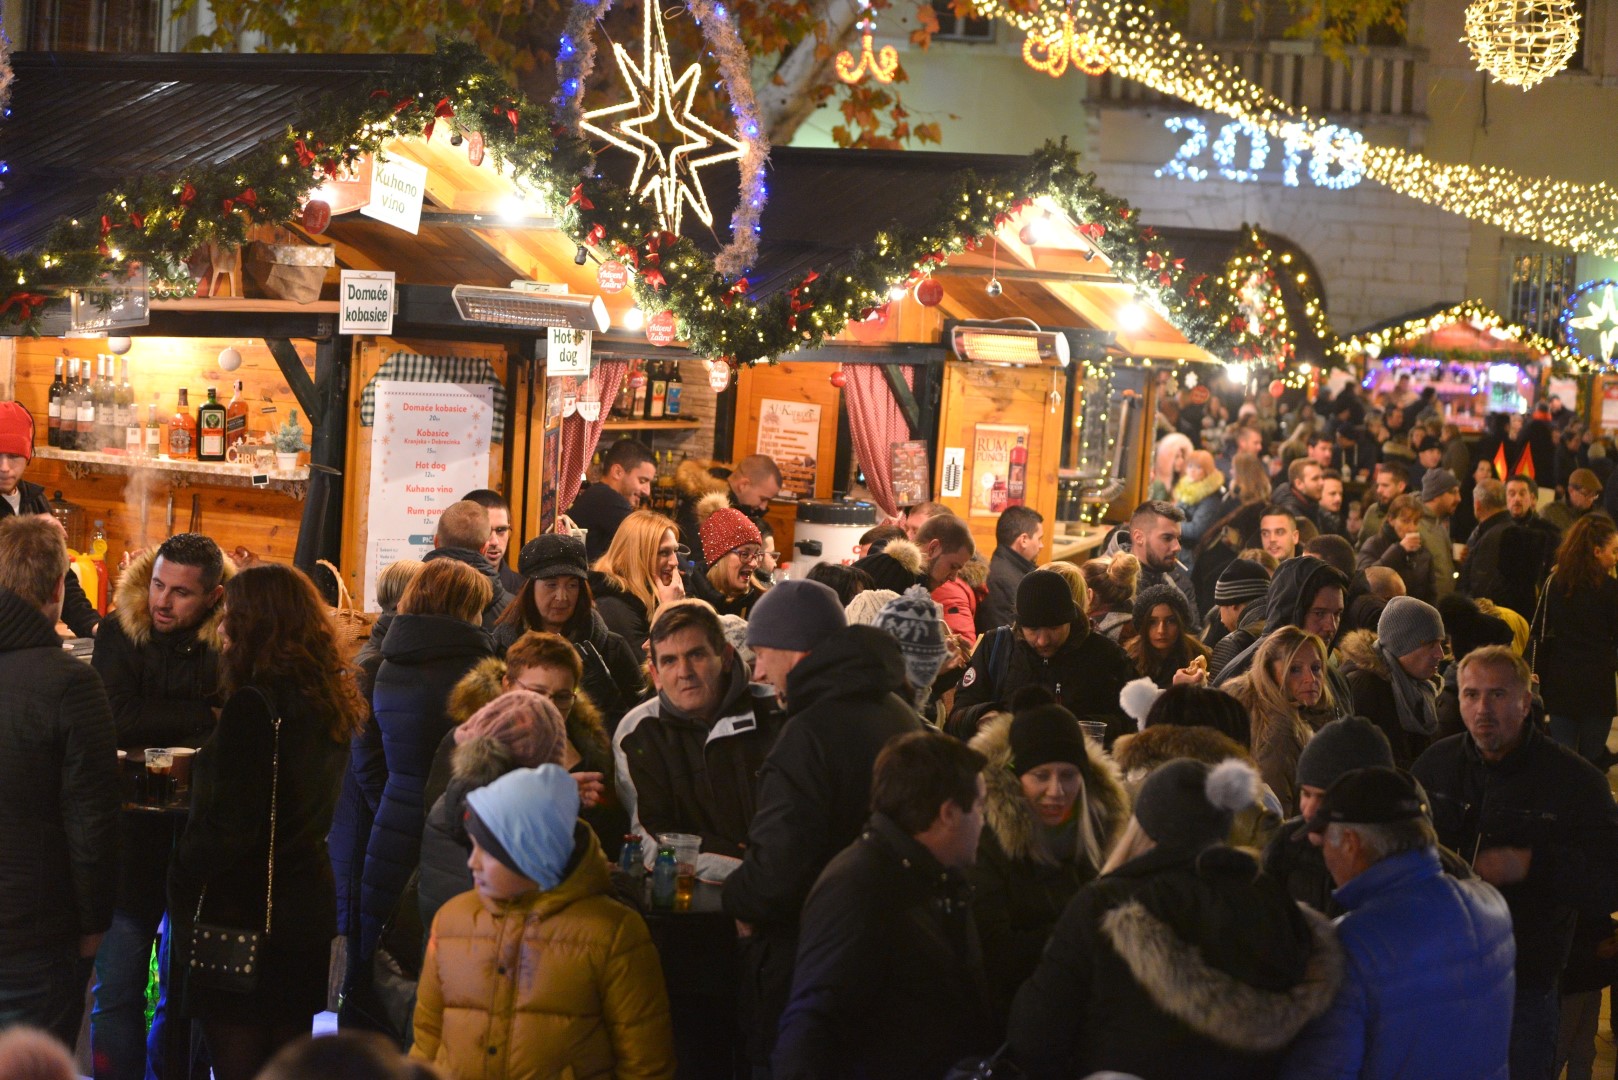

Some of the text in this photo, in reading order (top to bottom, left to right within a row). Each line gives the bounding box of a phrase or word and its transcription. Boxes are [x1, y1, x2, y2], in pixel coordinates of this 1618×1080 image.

[1154, 117, 1367, 190] 2018
[375, 166, 417, 198] Kuhano
[382, 194, 405, 214] vino
[347, 283, 388, 301] Domaće
[345, 306, 388, 322] kobasice
[553, 329, 572, 344] Hot
[559, 348, 578, 366] dog
[435, 403, 467, 413] kobasice
[416, 428, 449, 437] Kobasice
[977, 438, 1008, 452] RUM
[976, 451, 1008, 462] PUNCH
[415, 461, 446, 471] Hot dog
[405, 484, 454, 493] Kuhano vino
[407, 506, 425, 515] Rum
